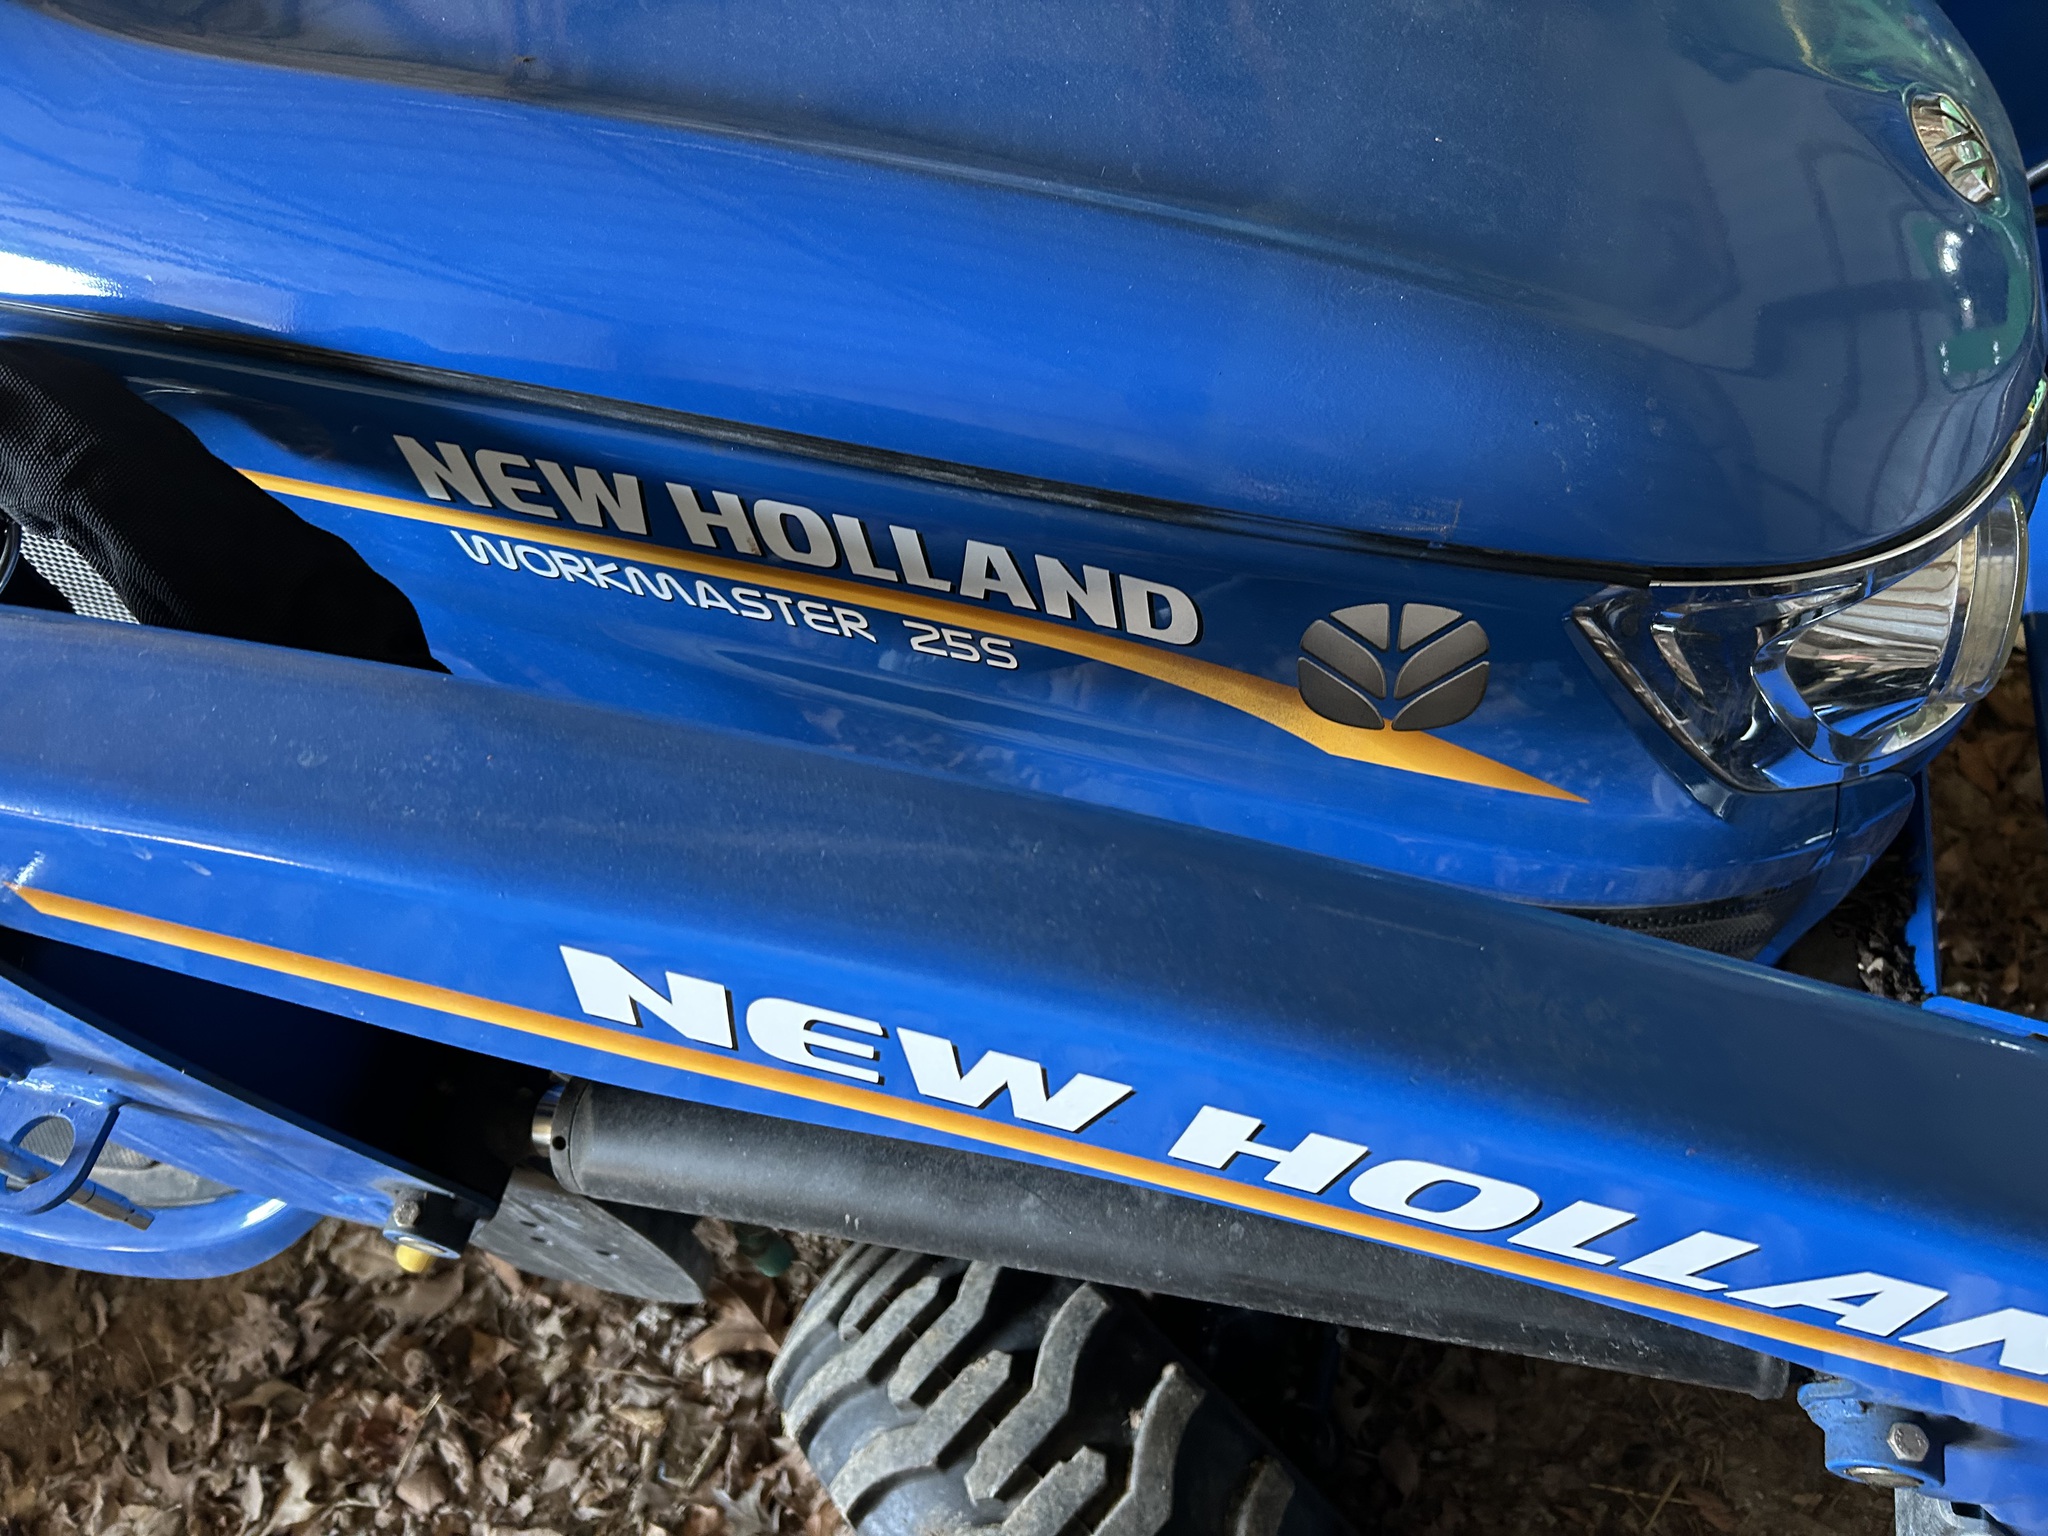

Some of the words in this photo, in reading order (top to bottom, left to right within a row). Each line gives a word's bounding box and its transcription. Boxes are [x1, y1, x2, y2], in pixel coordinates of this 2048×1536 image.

[392, 434, 650, 537] NEW
[666, 484, 1201, 647] HOLLAND
[449, 530, 878, 643] WORKMASTER
[902, 620, 1020, 671] 25S
[559, 945, 1137, 1134] NEW
